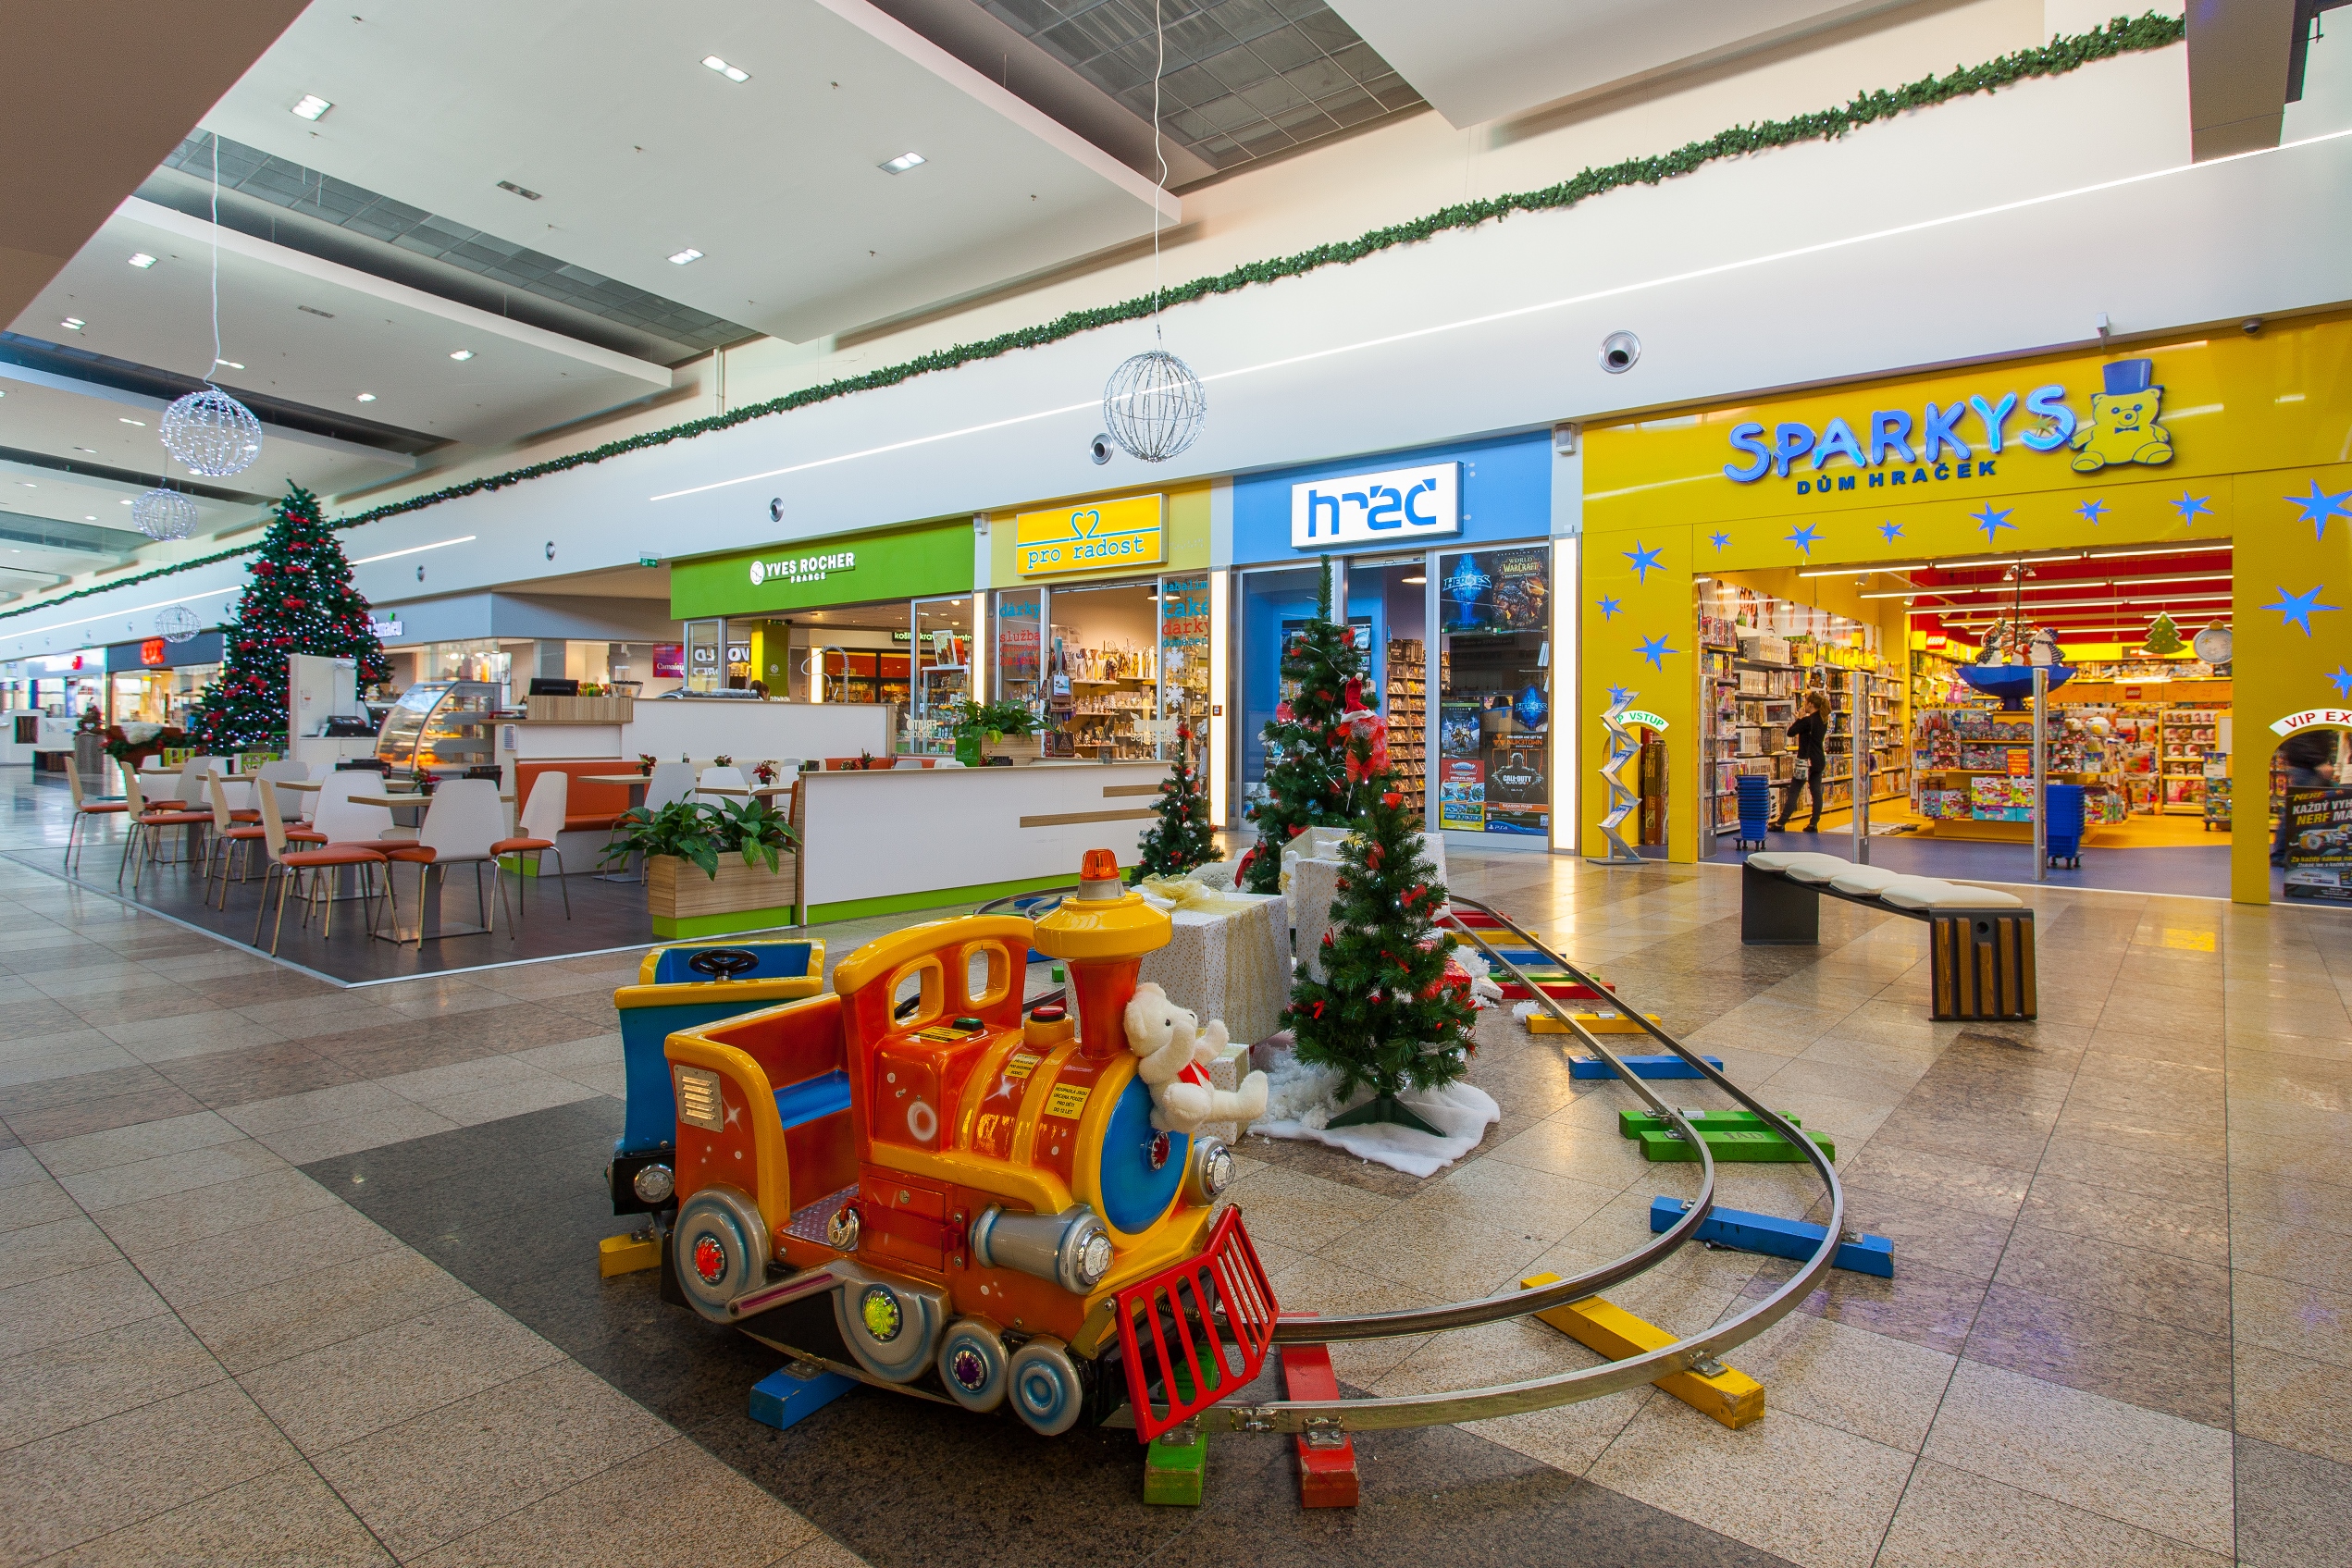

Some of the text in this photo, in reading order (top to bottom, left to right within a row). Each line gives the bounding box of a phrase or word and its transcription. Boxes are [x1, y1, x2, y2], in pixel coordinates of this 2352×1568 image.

[1724, 385, 2076, 483] SPARKYS
[1797, 460, 1997, 495] DŮM HRAČEK
[1027, 536, 1145, 570] pro radost
[765, 552, 856, 577] YVES ROCHER
[790, 572, 827, 584] FRANCE
[1000, 601, 1042, 619] dárky
[1162, 597, 1209, 619] také
[894, 632, 911, 640] košil
[999, 630, 1041, 643] služba
[1926, 636, 1947, 645] LEGO
[1000, 652, 1041, 666] balení
[1629, 712, 1665, 726] VSTUP
[2284, 711, 2317, 728] VIP
[2293, 791, 2325, 802] NERF
[2292, 799, 2330, 815] KAŽDÝ
[2296, 812, 2330, 826] NERF
